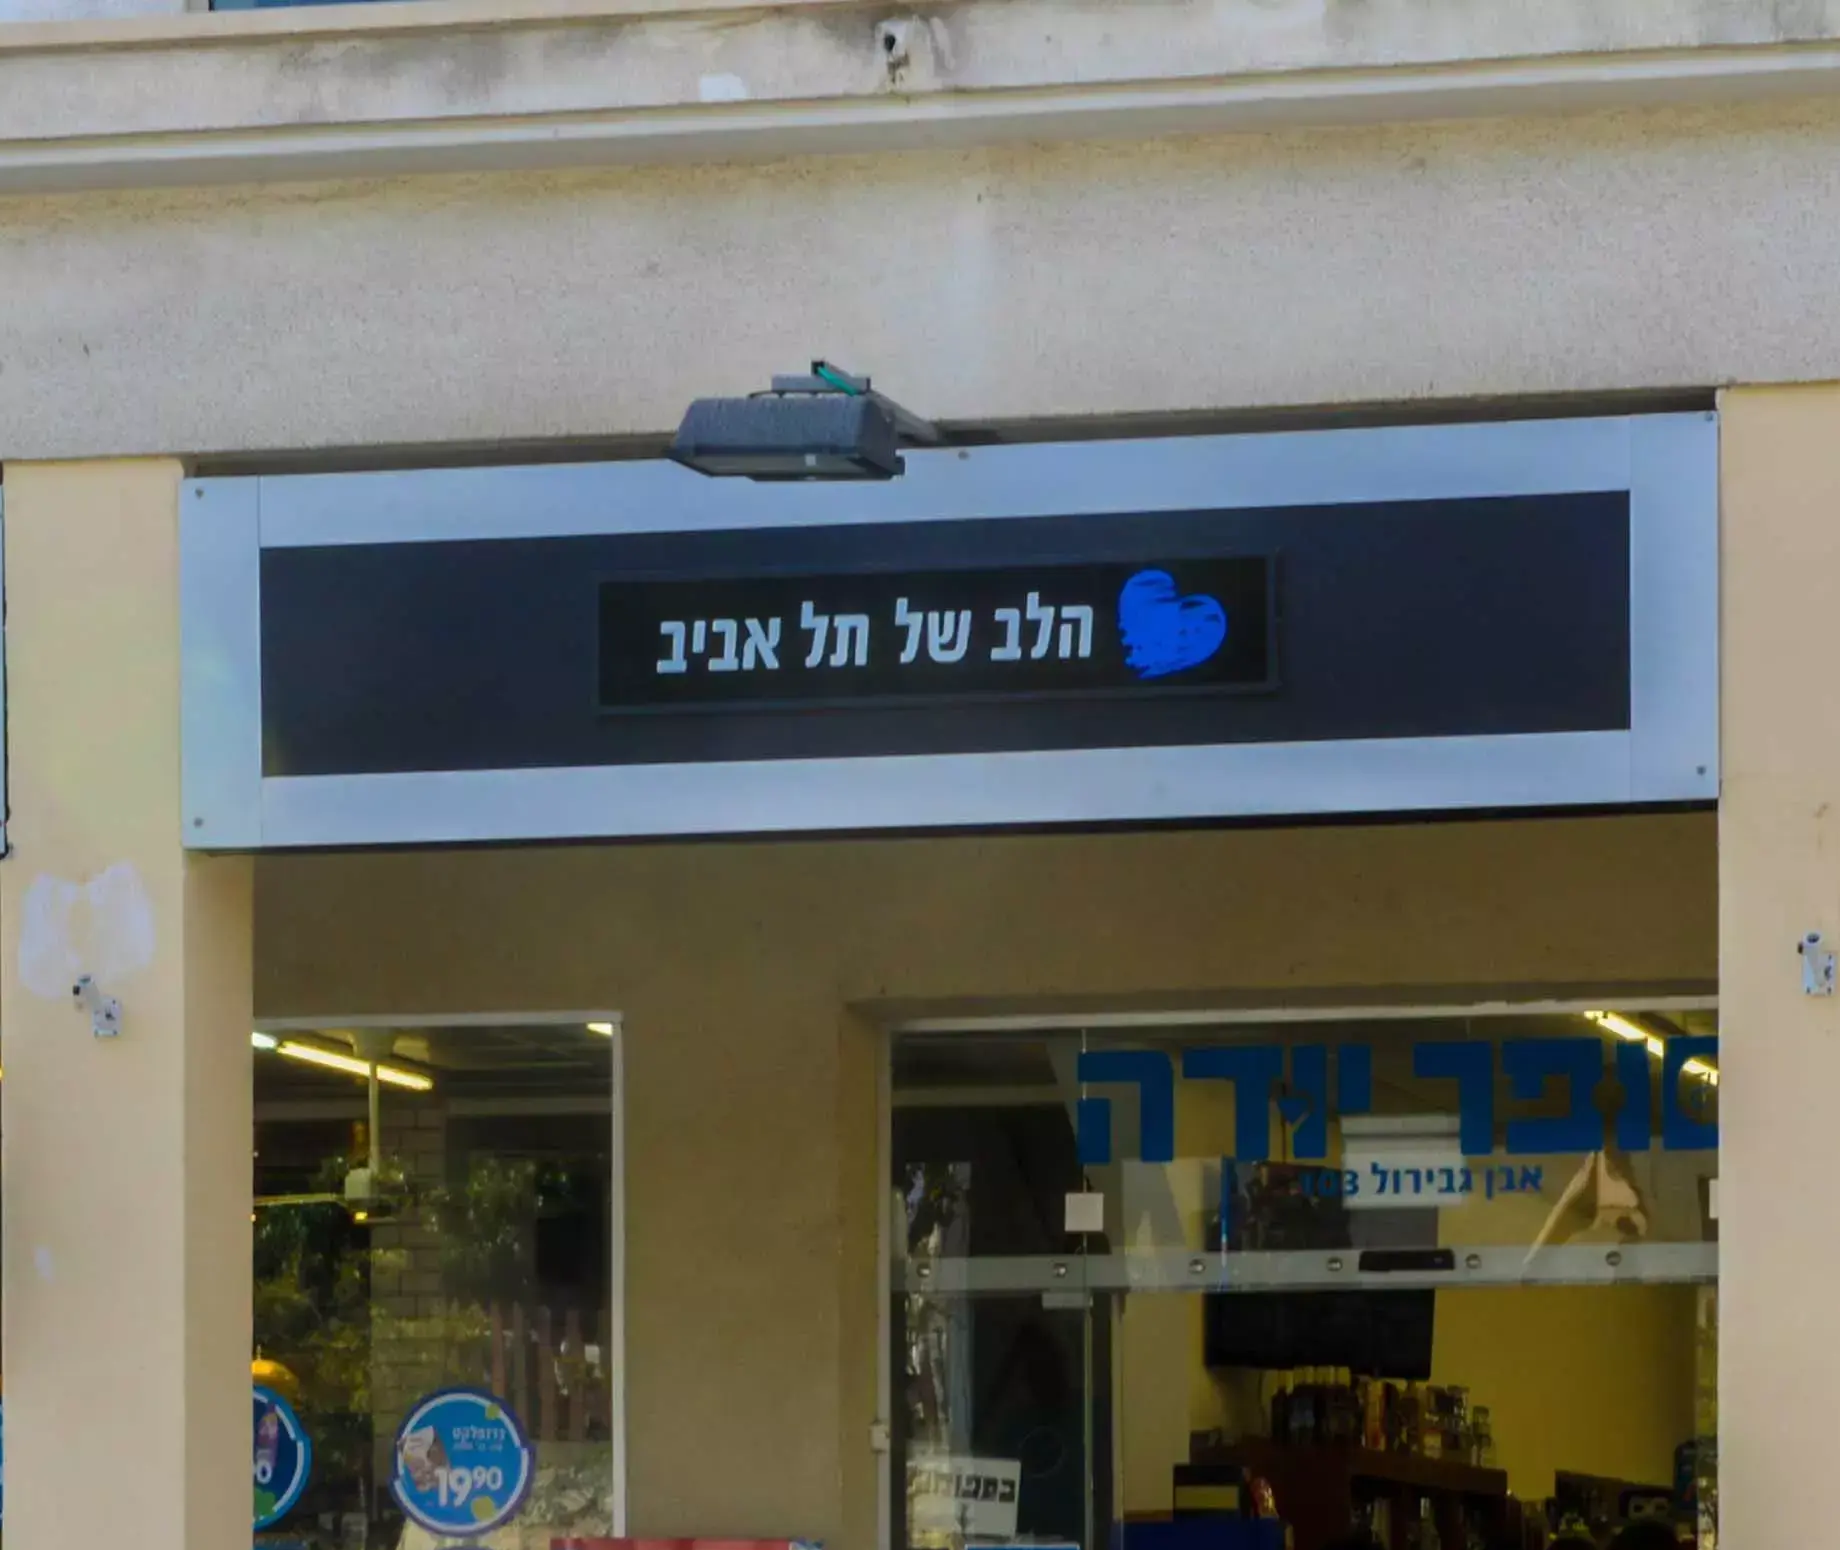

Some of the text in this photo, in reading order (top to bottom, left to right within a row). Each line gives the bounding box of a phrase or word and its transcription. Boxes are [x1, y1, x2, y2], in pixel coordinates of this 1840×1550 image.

[656, 591, 1093, 673] הלב של תל אביב
[1077, 1044, 1373, 1166] יודה
[1371, 1159, 1474, 1199] גבירול
[1483, 1163, 1544, 1199] אבן
